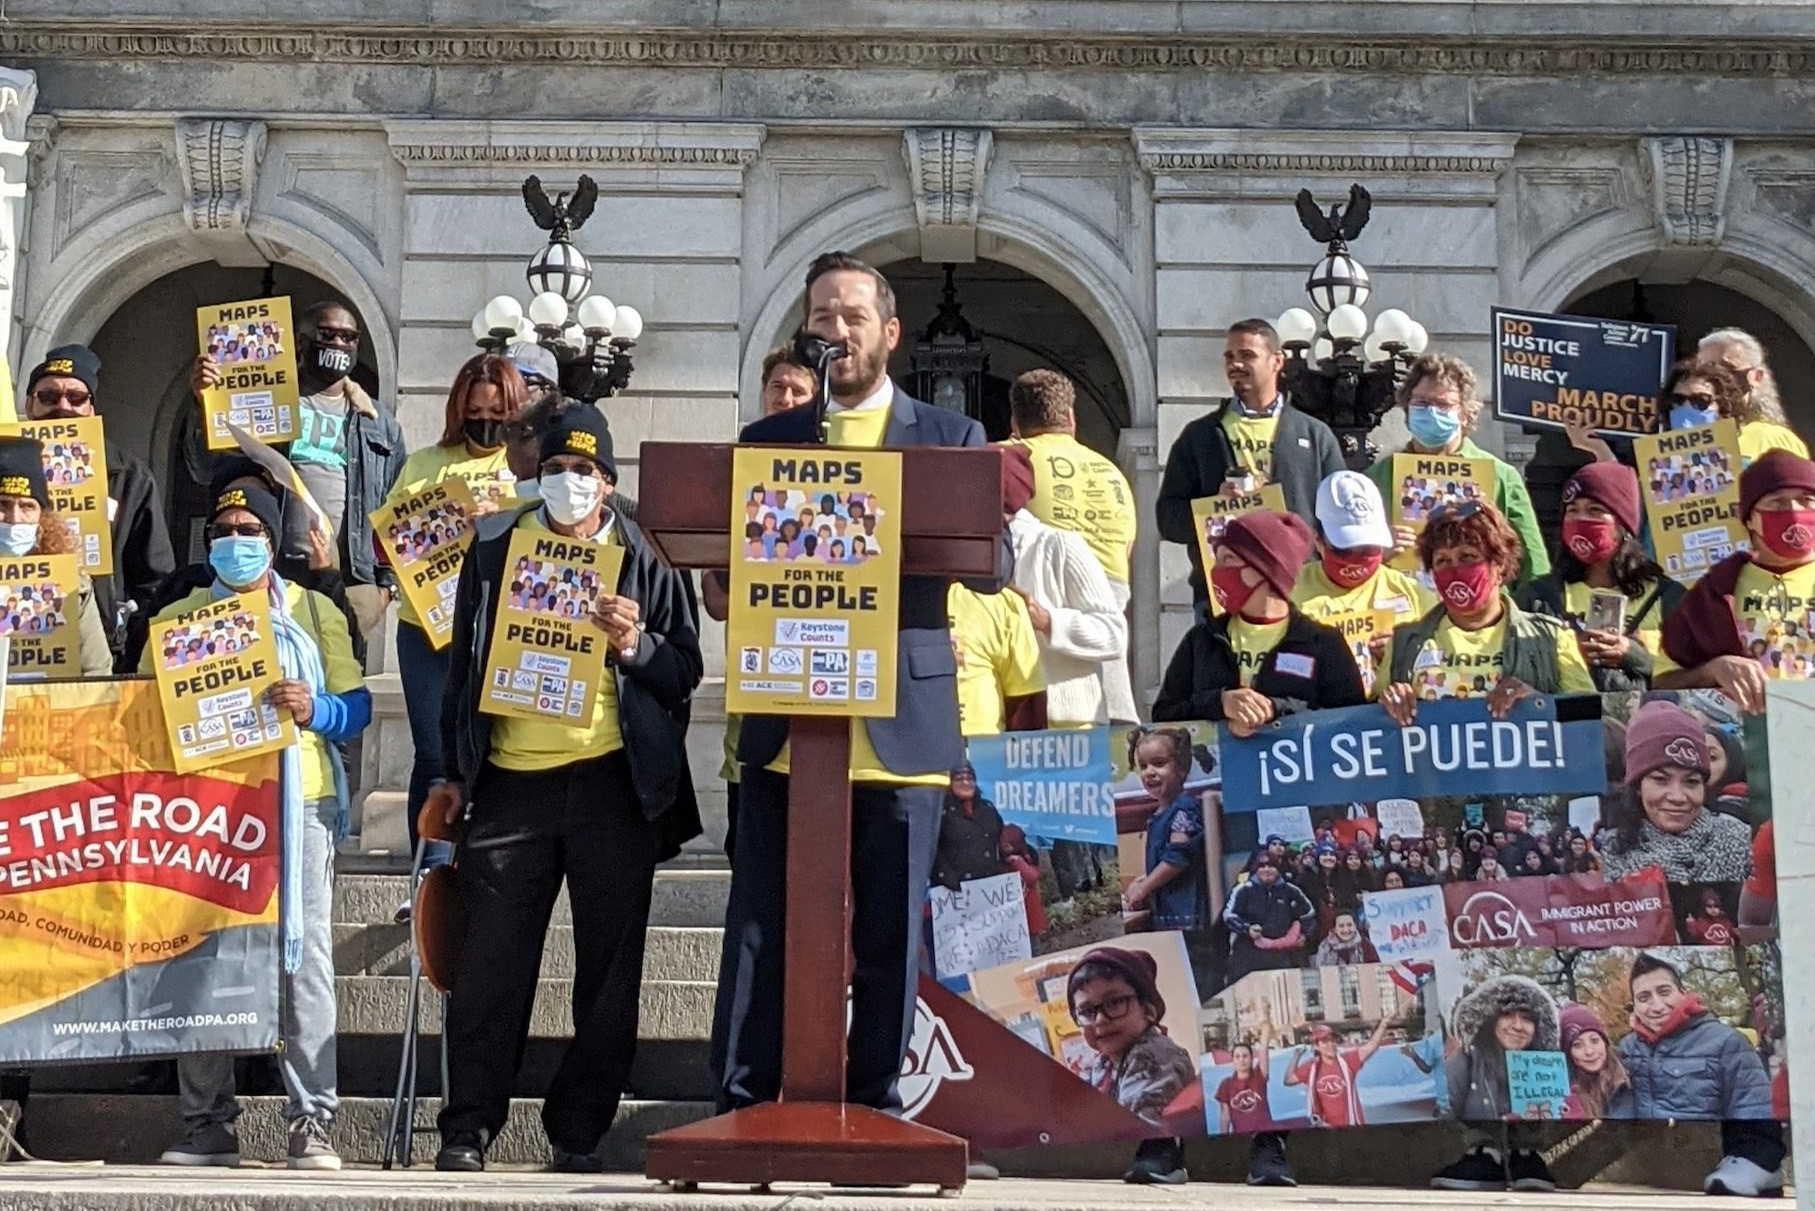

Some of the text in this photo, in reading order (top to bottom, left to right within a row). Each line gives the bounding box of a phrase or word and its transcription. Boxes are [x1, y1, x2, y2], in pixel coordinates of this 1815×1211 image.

[219, 304, 270, 322] MAPS
[1504, 320, 1533, 335] DO
[1502, 334, 1581, 356] JUSTICE
[1504, 350, 1552, 368] LOVE
[214, 370, 287, 391] PEOPLE
[1503, 364, 1569, 386] MERCY
[1557, 387, 1657, 415] MARCH
[1531, 401, 1656, 433] PROUDLY
[21, 424, 78, 440] MAPS
[1658, 429, 1714, 453] MAPS
[773, 459, 862, 484] MAPS
[1417, 460, 1472, 476] MAPS
[393, 486, 447, 519] MAPS
[1213, 492, 1264, 514] MAPS
[1679, 501, 1698, 511] FOR
[535, 538, 597, 564] MAPS
[0, 562, 51, 582] APS
[784, 570, 844, 581] FOR THE
[750, 583, 878, 610] PEOPLE
[177, 599, 241, 625] MAPS
[532, 617, 572, 631] FOR THE
[800, 622, 845, 633] Keystone
[21, 638, 42, 647] THE
[507, 624, 594, 654] PEOPLE
[800, 633, 835, 642] Counts
[8, 647, 67, 667] OPLE
[196, 656, 240, 674] FOR THE
[770, 655, 801, 667] CASA
[174, 659, 268, 698] PEOPLE
[1006, 734, 1090, 769] DEFEND
[1258, 720, 1566, 795] ¡SÍ SE PUEDE!
[995, 781, 1115, 817] DREAMERS
[20, 795, 119, 849] THE
[131, 792, 267, 851] ROAD
[1390, 920, 1427, 941] DACA
[1453, 897, 1662, 944] CASA IMMIGRANT POWER
[1570, 917, 1638, 933] IN ACTION
[36, 918, 123, 953] COMUNIDAD
[128, 943, 138, 954] Y
[141, 934, 190, 954] PODER
[53, 1012, 258, 1035] WWW.MAKETHEROADPA.ORG
[1512, 1086, 1568, 1099] ILLEGAL
